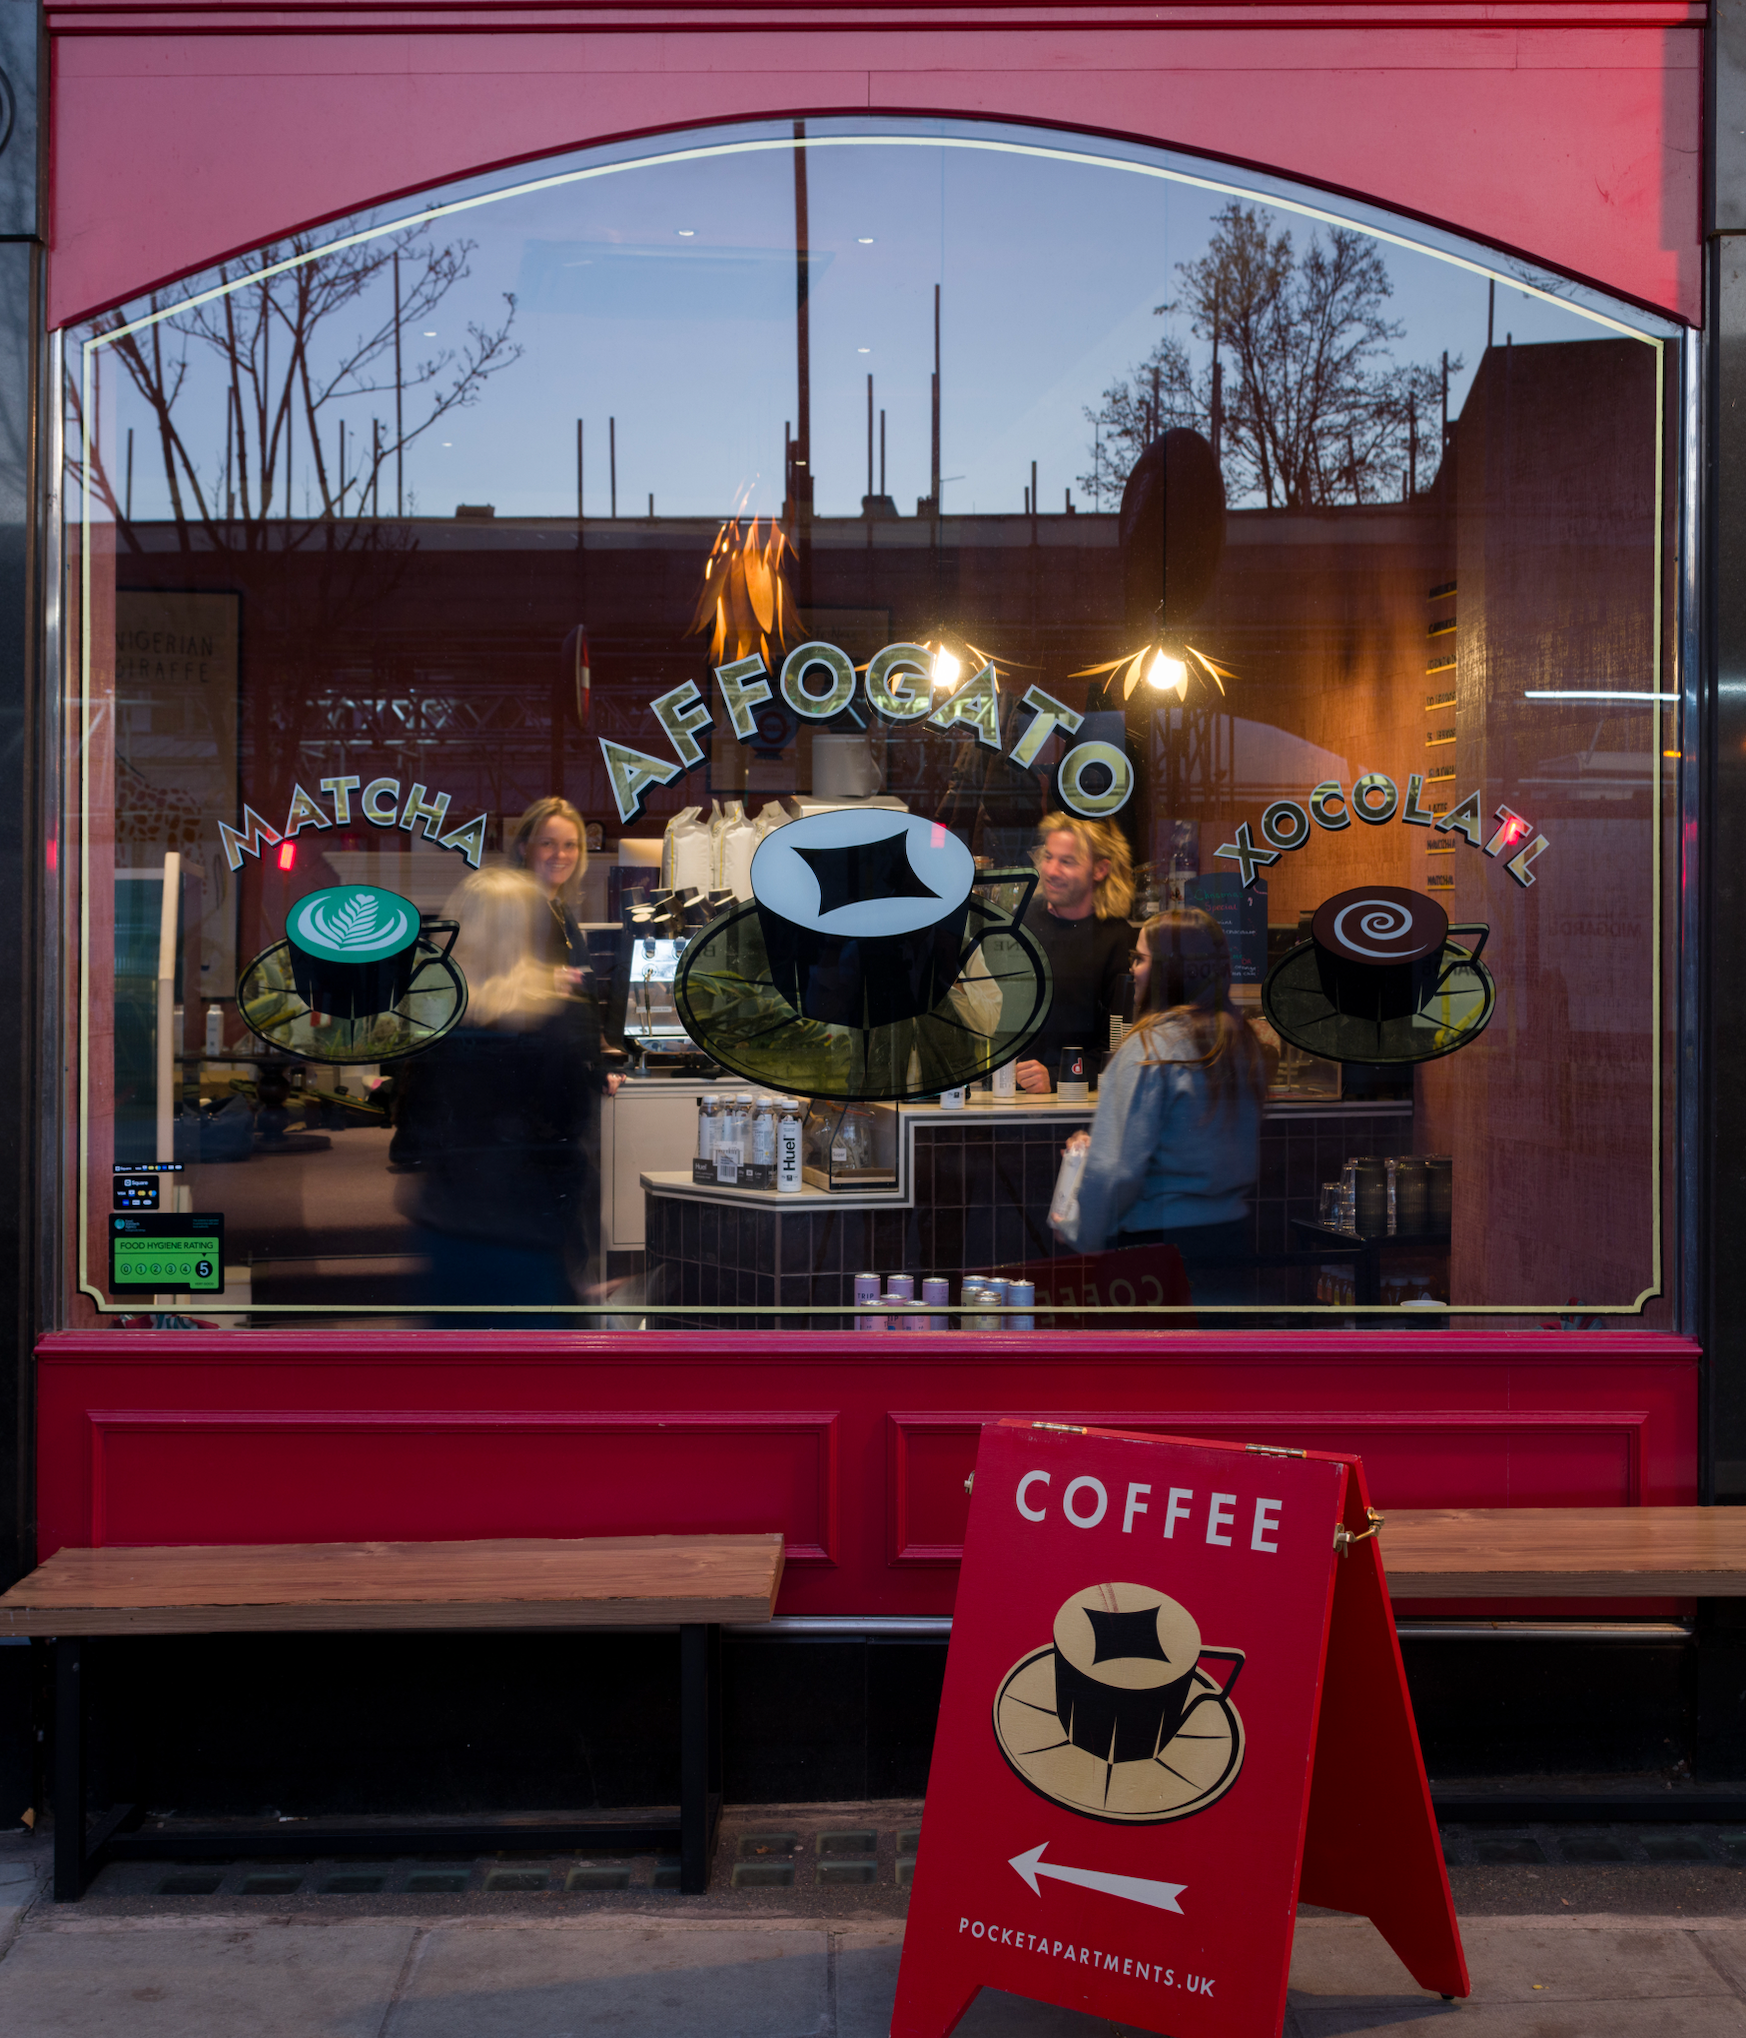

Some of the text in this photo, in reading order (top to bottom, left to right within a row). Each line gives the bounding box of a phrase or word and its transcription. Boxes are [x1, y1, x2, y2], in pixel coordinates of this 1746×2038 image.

[115, 630, 213, 657] NIGERIAN
[115, 658, 209, 683] GIRAFFE
[596, 640, 1136, 825] AFFOGATO
[217, 774, 489, 872] MATCHA
[1213, 772, 1551, 889] XOCOLATL
[1204, 900, 1238, 914] Special
[695, 1163, 707, 1171] Huel
[783, 1137, 796, 1171] Huel
[120, 1241, 213, 1250] FOOD HYGIENE RATING
[124, 1265, 129, 1273] 0
[153, 1265, 159, 1273] 2
[168, 1265, 173, 1273] 3
[182, 1265, 189, 1273] 4
[199, 1262, 208, 1276] 5
[1014, 1469, 1284, 1554] COFFEE
[958, 1916, 1216, 1998] POCKETAPARTMENTS.UK
